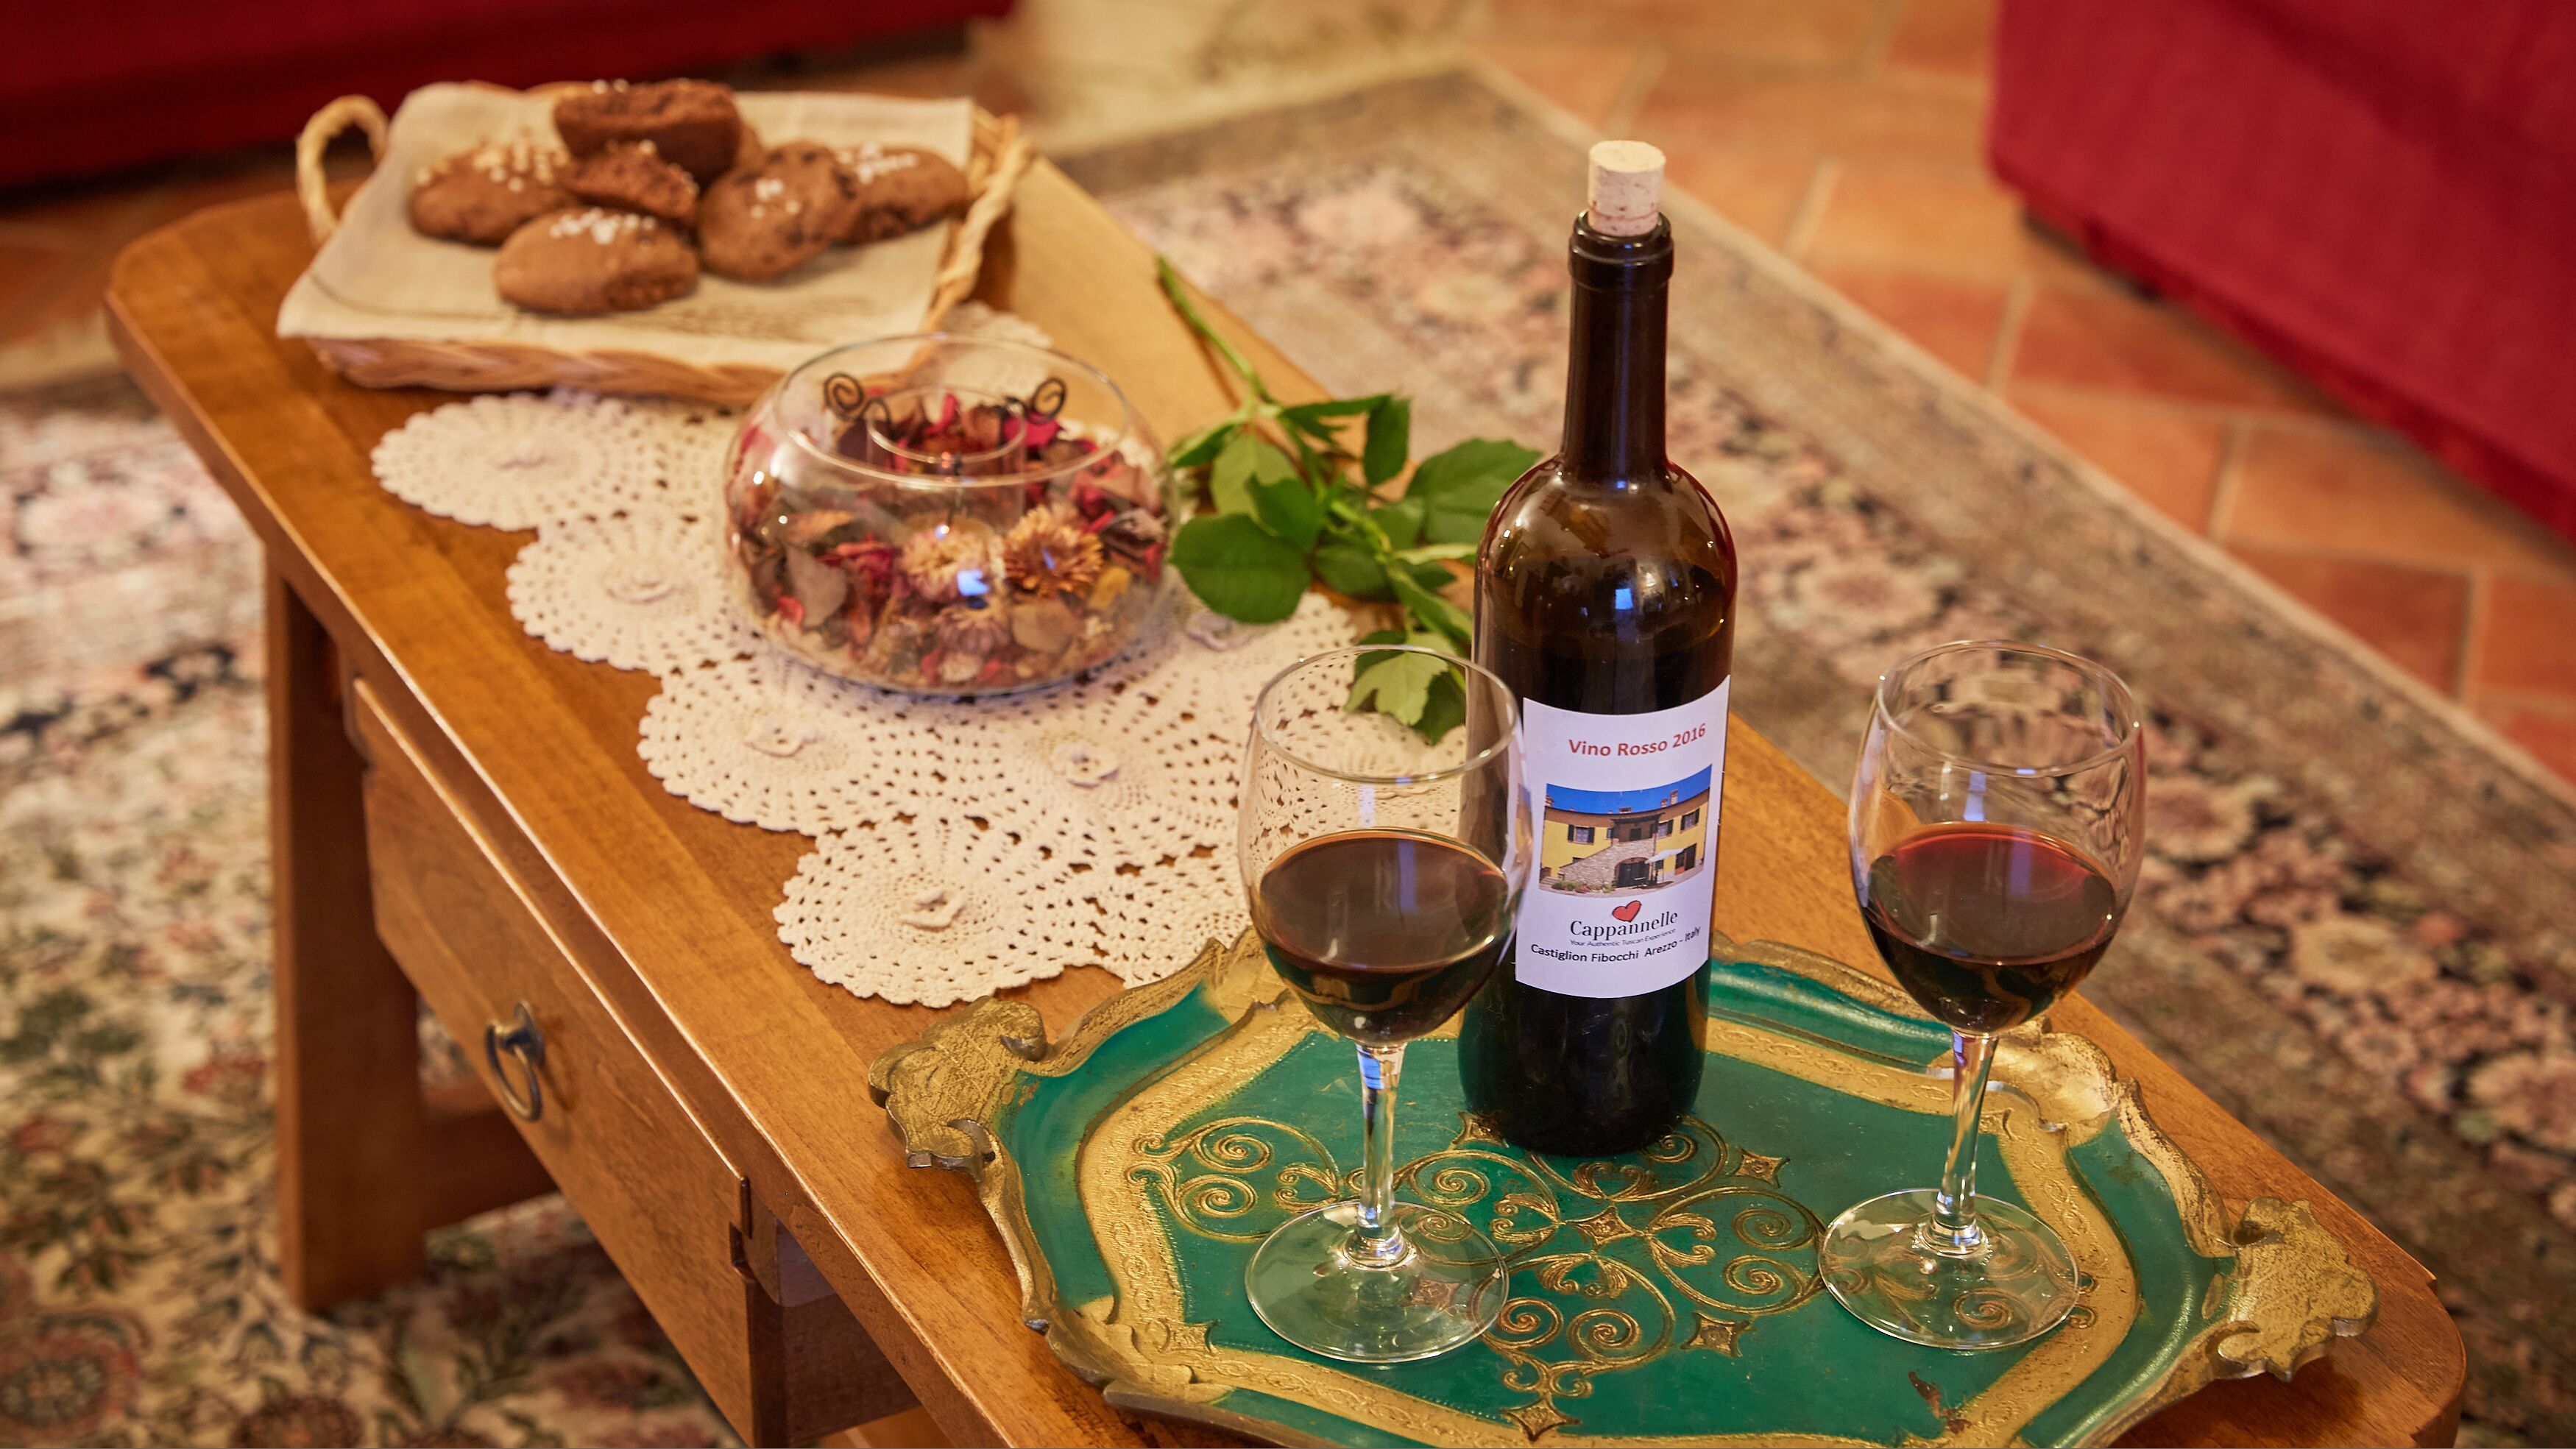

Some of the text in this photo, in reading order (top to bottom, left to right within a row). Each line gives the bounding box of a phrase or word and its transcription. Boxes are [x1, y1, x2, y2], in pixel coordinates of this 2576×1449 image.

[1568, 723, 1706, 757] Vino Rosso 2016
[1570, 911, 1678, 941] Cappannelle
[1644, 929, 1676, 942] Experience
[1531, 943, 1588, 962] Castiglion
[1591, 950, 1639, 963] Fibocchi
[1644, 940, 1677, 957] Arezzo
[1684, 926, 1701, 943] Italy
